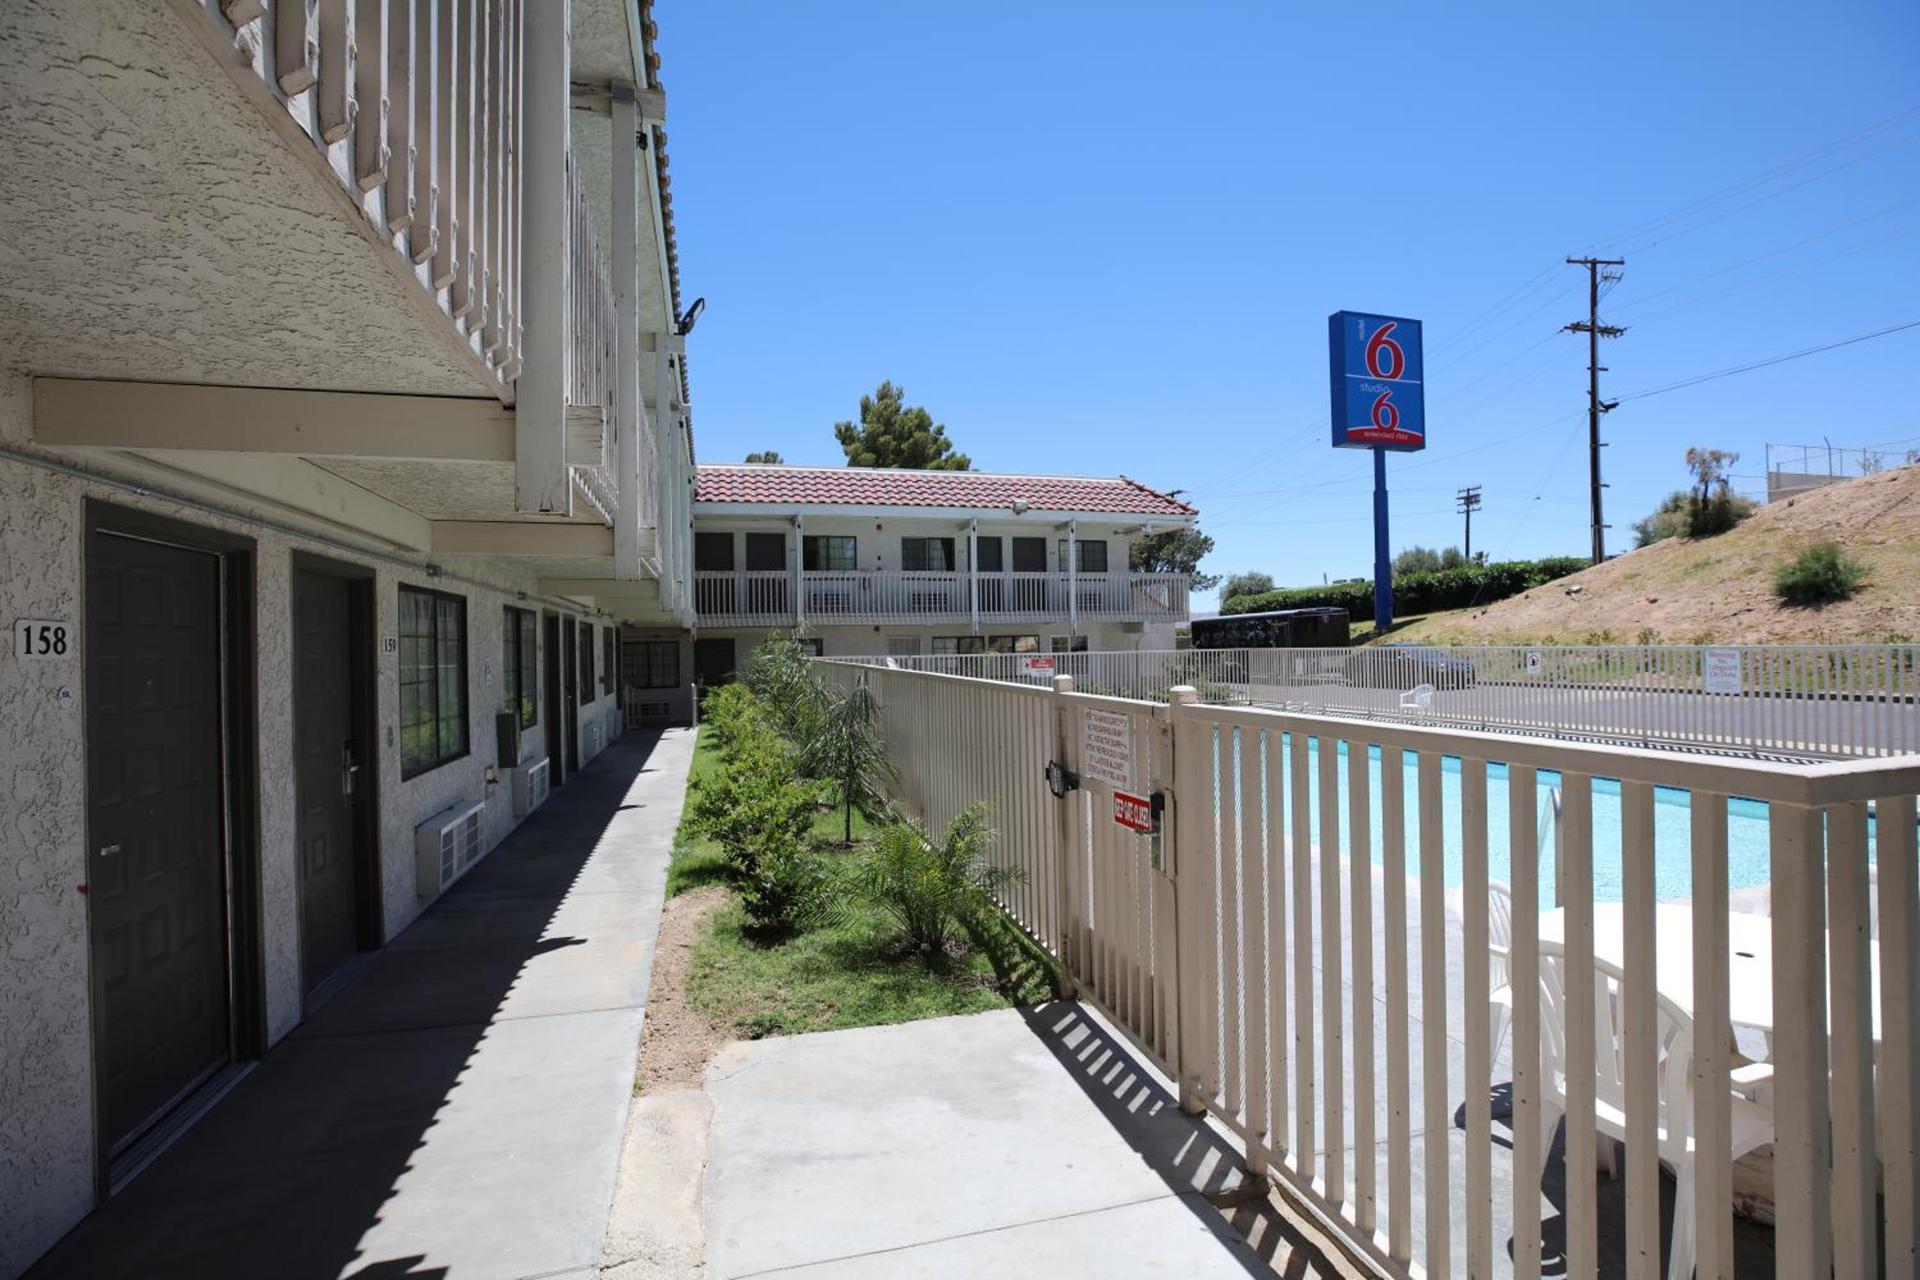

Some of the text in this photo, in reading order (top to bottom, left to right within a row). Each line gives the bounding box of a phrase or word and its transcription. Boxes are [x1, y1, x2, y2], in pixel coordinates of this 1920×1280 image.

[1365, 321, 1405, 380] 6
[1360, 382, 1390, 393] studio
[1372, 391, 1399, 431] 6
[23, 625, 67, 655] 158
[384, 638, 396, 653] 159
